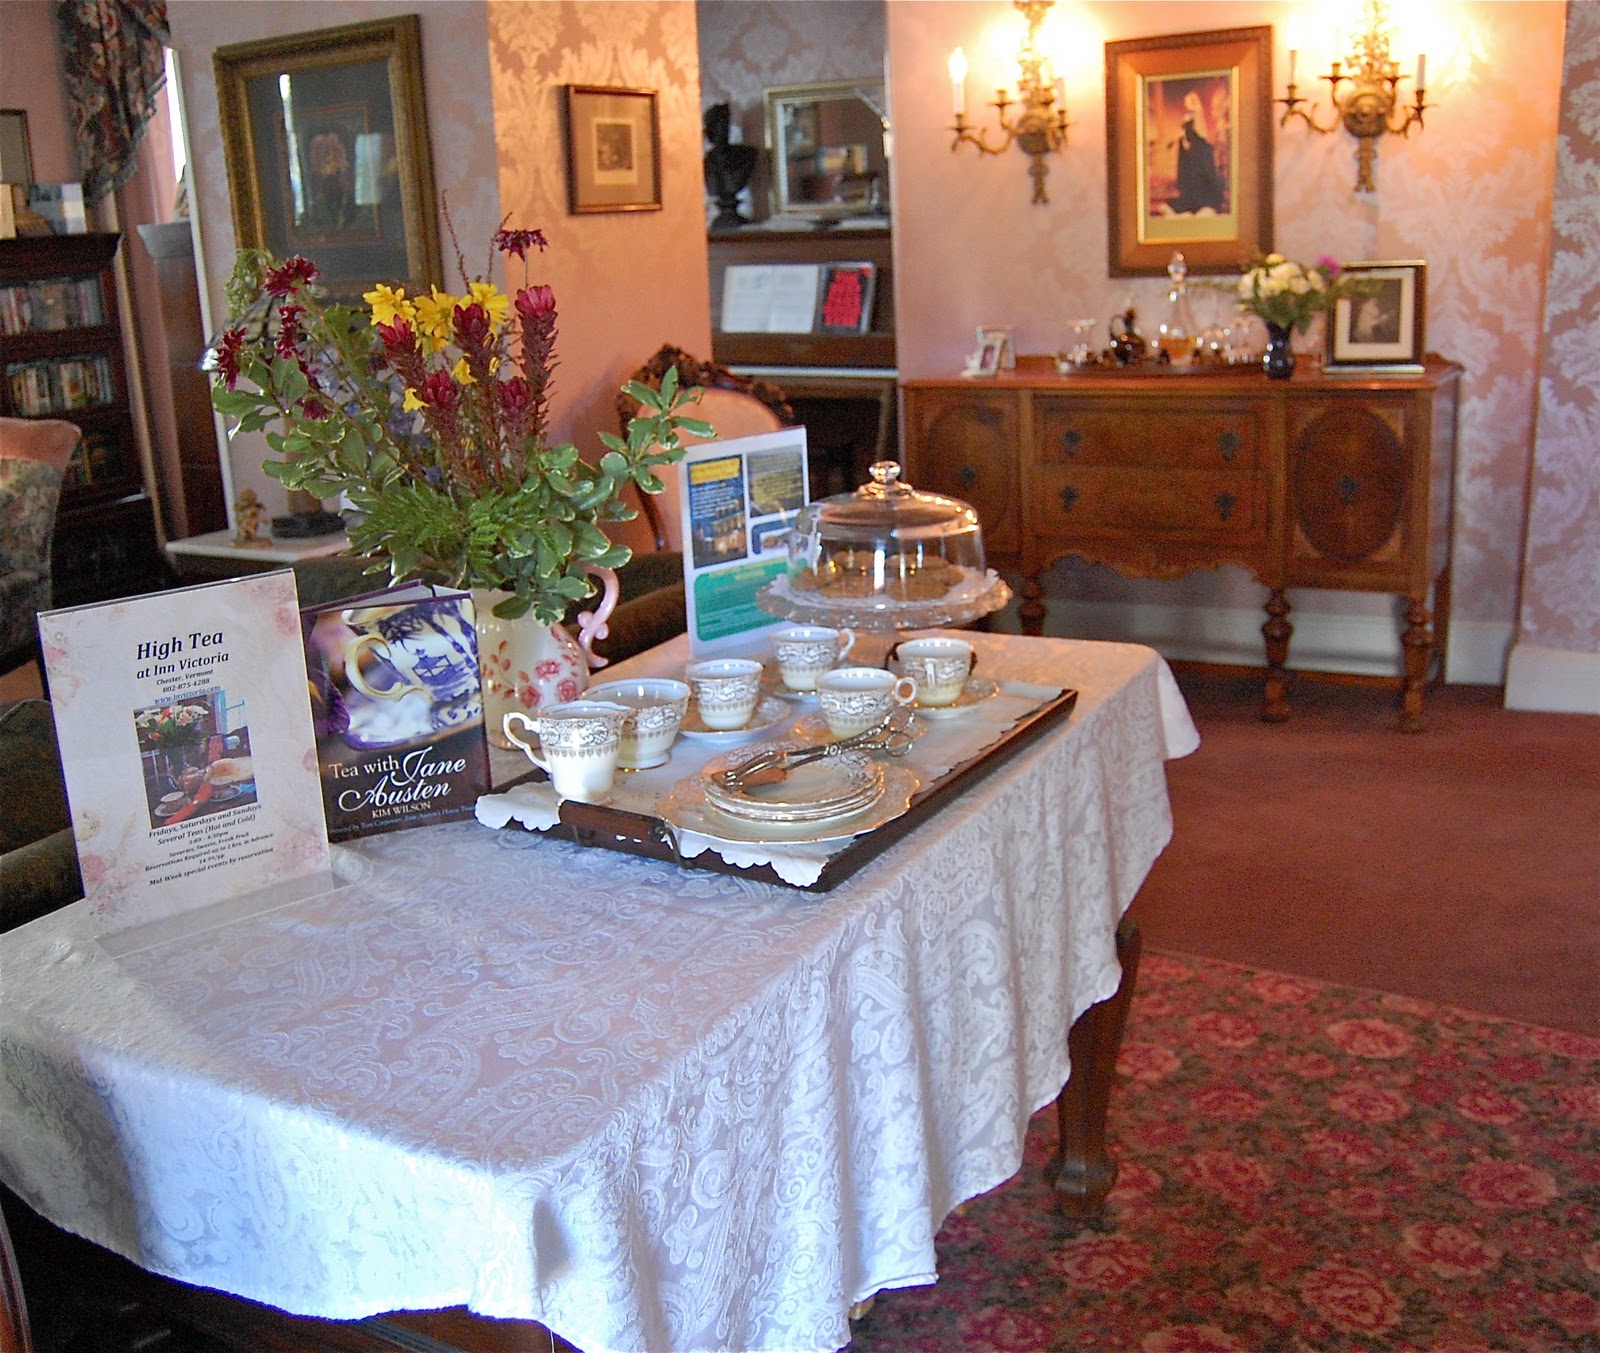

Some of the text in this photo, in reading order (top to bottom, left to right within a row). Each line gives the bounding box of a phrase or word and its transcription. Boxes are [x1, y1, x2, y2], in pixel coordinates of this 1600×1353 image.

[137, 632, 223, 660] High Tea
[136, 652, 229, 679] at Inn Victoria
[156, 669, 214, 686] Chester, Vermont
[328, 746, 466, 786] Tea with Jane
[338, 775, 451, 812] Austen
[149, 805, 261, 838] Fridays, Saturdays and Sundays
[372, 801, 432, 819] KIM WILSON
[158, 814, 256, 845] Several Teas (Hot and Cold)
[218, 836, 234, 844] Fresh
[145, 858, 183, 872] Reservations
[184, 865, 206, 877] special
[207, 860, 228, 870] events
[238, 848, 274, 860] reservation
